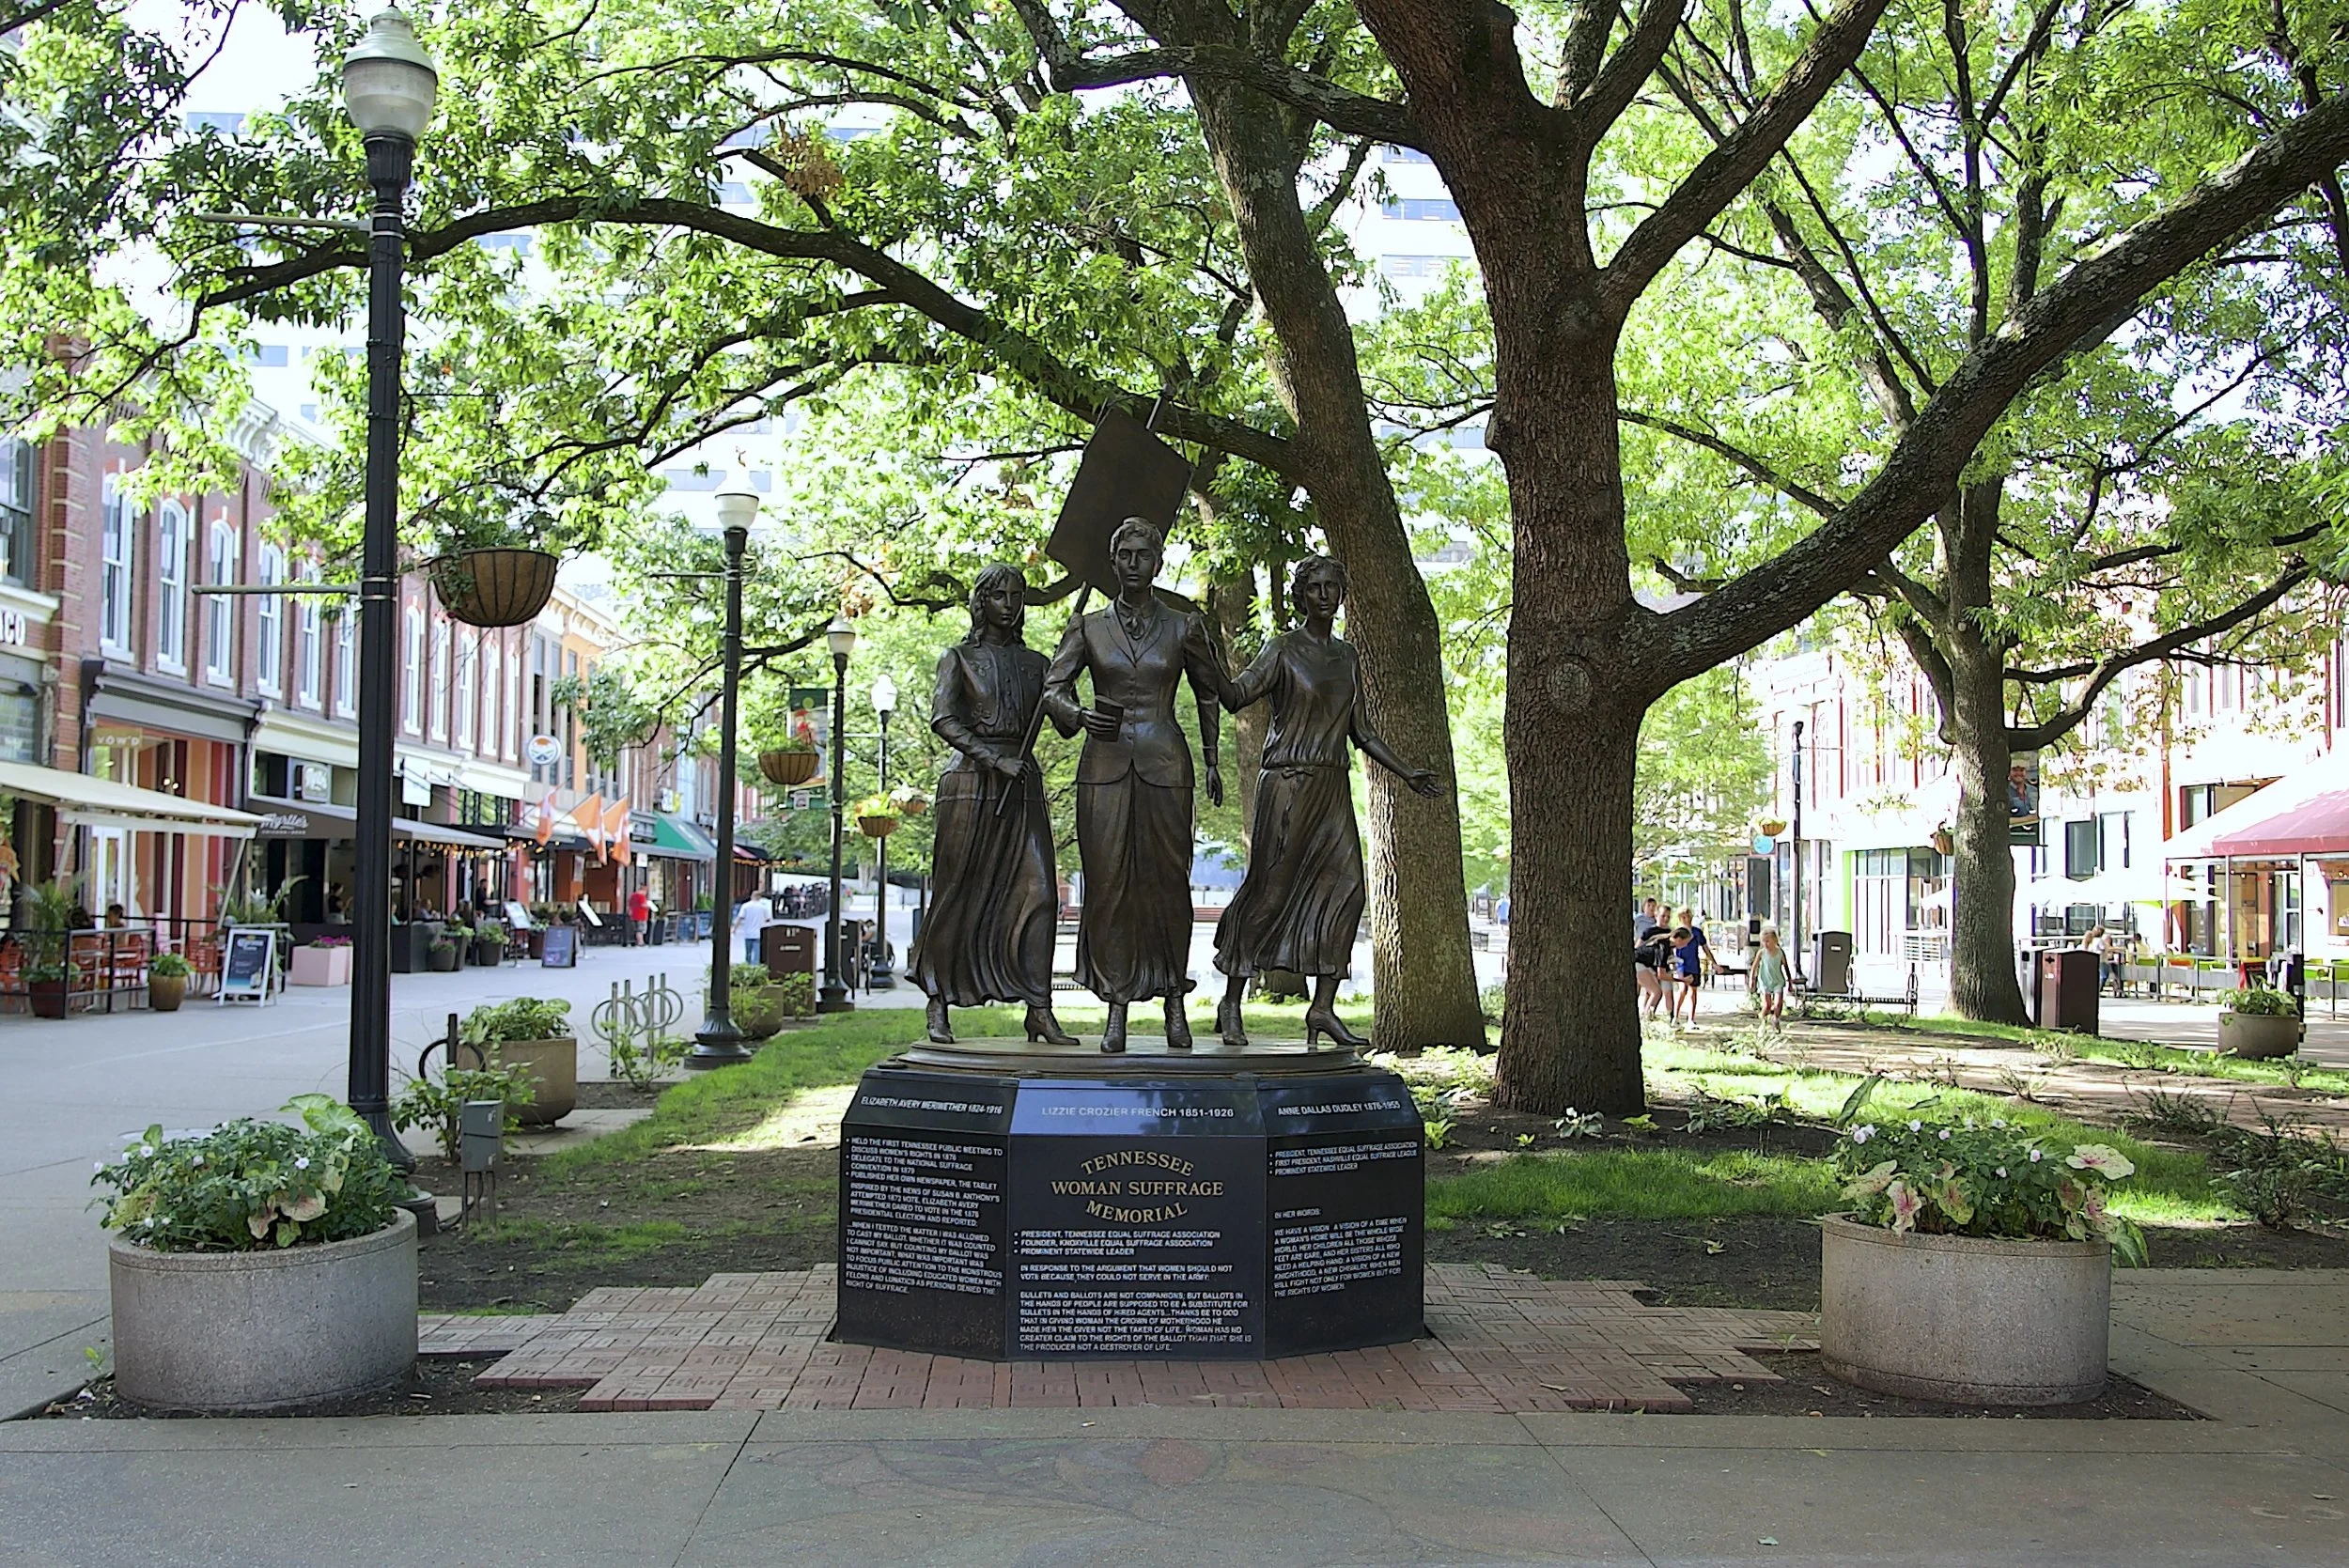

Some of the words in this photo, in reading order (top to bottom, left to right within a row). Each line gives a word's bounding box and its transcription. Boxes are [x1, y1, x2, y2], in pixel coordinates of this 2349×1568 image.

[0, 609, 25, 646] CO
[1042, 1107, 1075, 1116] LIZZIE
[1079, 1107, 1128, 1117] CROZIER
[1131, 1108, 1176, 1117] FRENCH
[1081, 1151, 1194, 1176] TENNESSEE
[1051, 1181, 1121, 1195] WOMAN
[1128, 1181, 1224, 1195] SUFFRAGE
[1086, 1200, 1188, 1223] MEMORIAL
